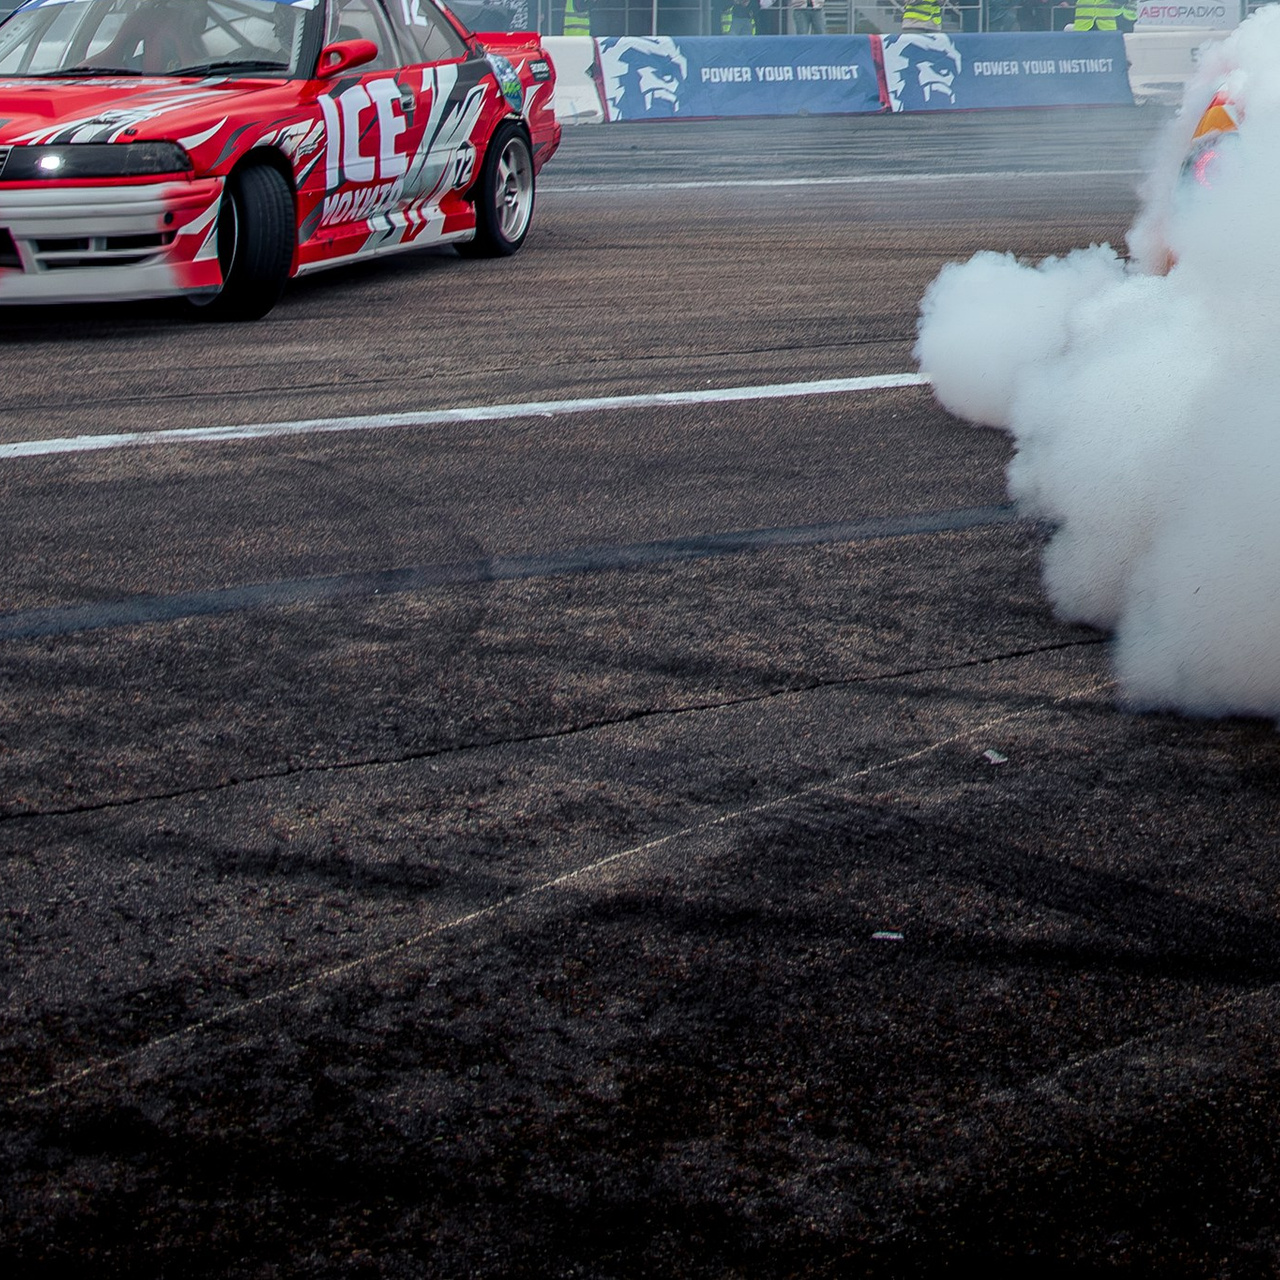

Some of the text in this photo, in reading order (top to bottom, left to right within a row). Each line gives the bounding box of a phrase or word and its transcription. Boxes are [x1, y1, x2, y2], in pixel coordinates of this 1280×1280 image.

[1139, 5, 1226, 19] АВТОРАДИО
[701, 64, 859, 83] POWER YOUR INSTINCT
[974, 58, 1114, 77] POWER YOUR INSTINCT
[316, 77, 409, 192] ICE
[453, 146, 475, 186] 72
